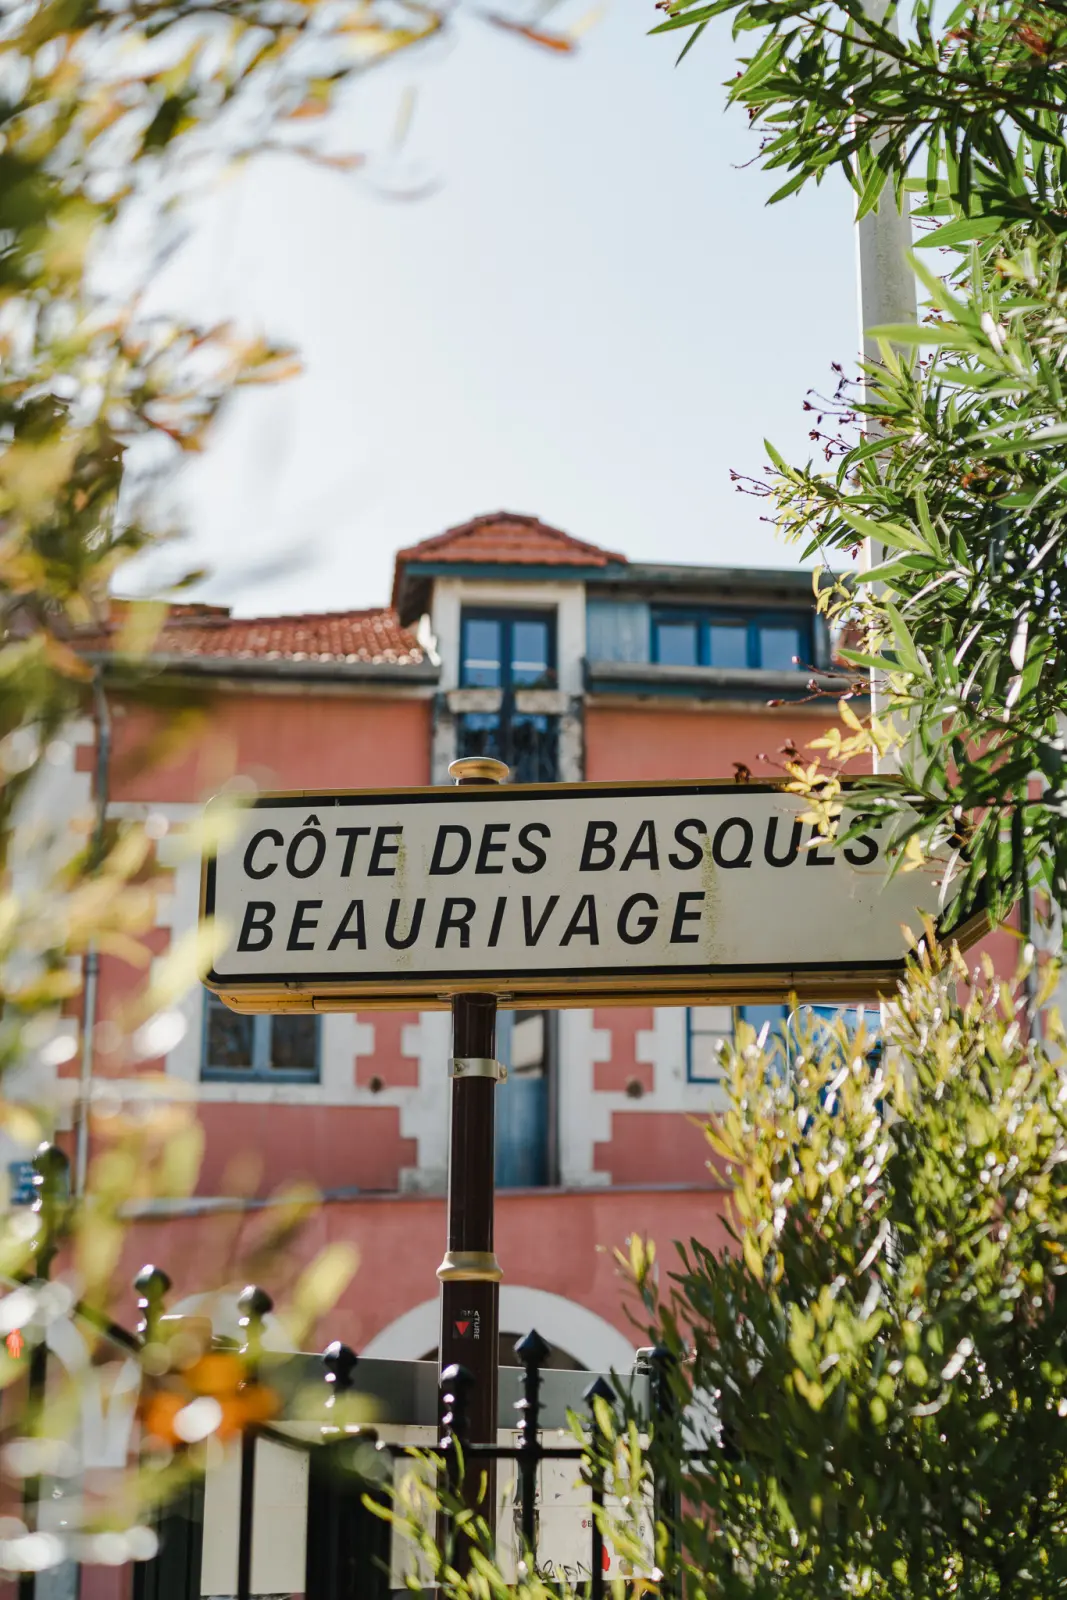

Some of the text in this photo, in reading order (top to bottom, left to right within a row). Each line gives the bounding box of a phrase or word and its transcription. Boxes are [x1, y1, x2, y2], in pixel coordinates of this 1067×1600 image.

[243, 813, 883, 880] CÔTE DES BASQUES
[236, 891, 706, 952] BEAURIVAGE
